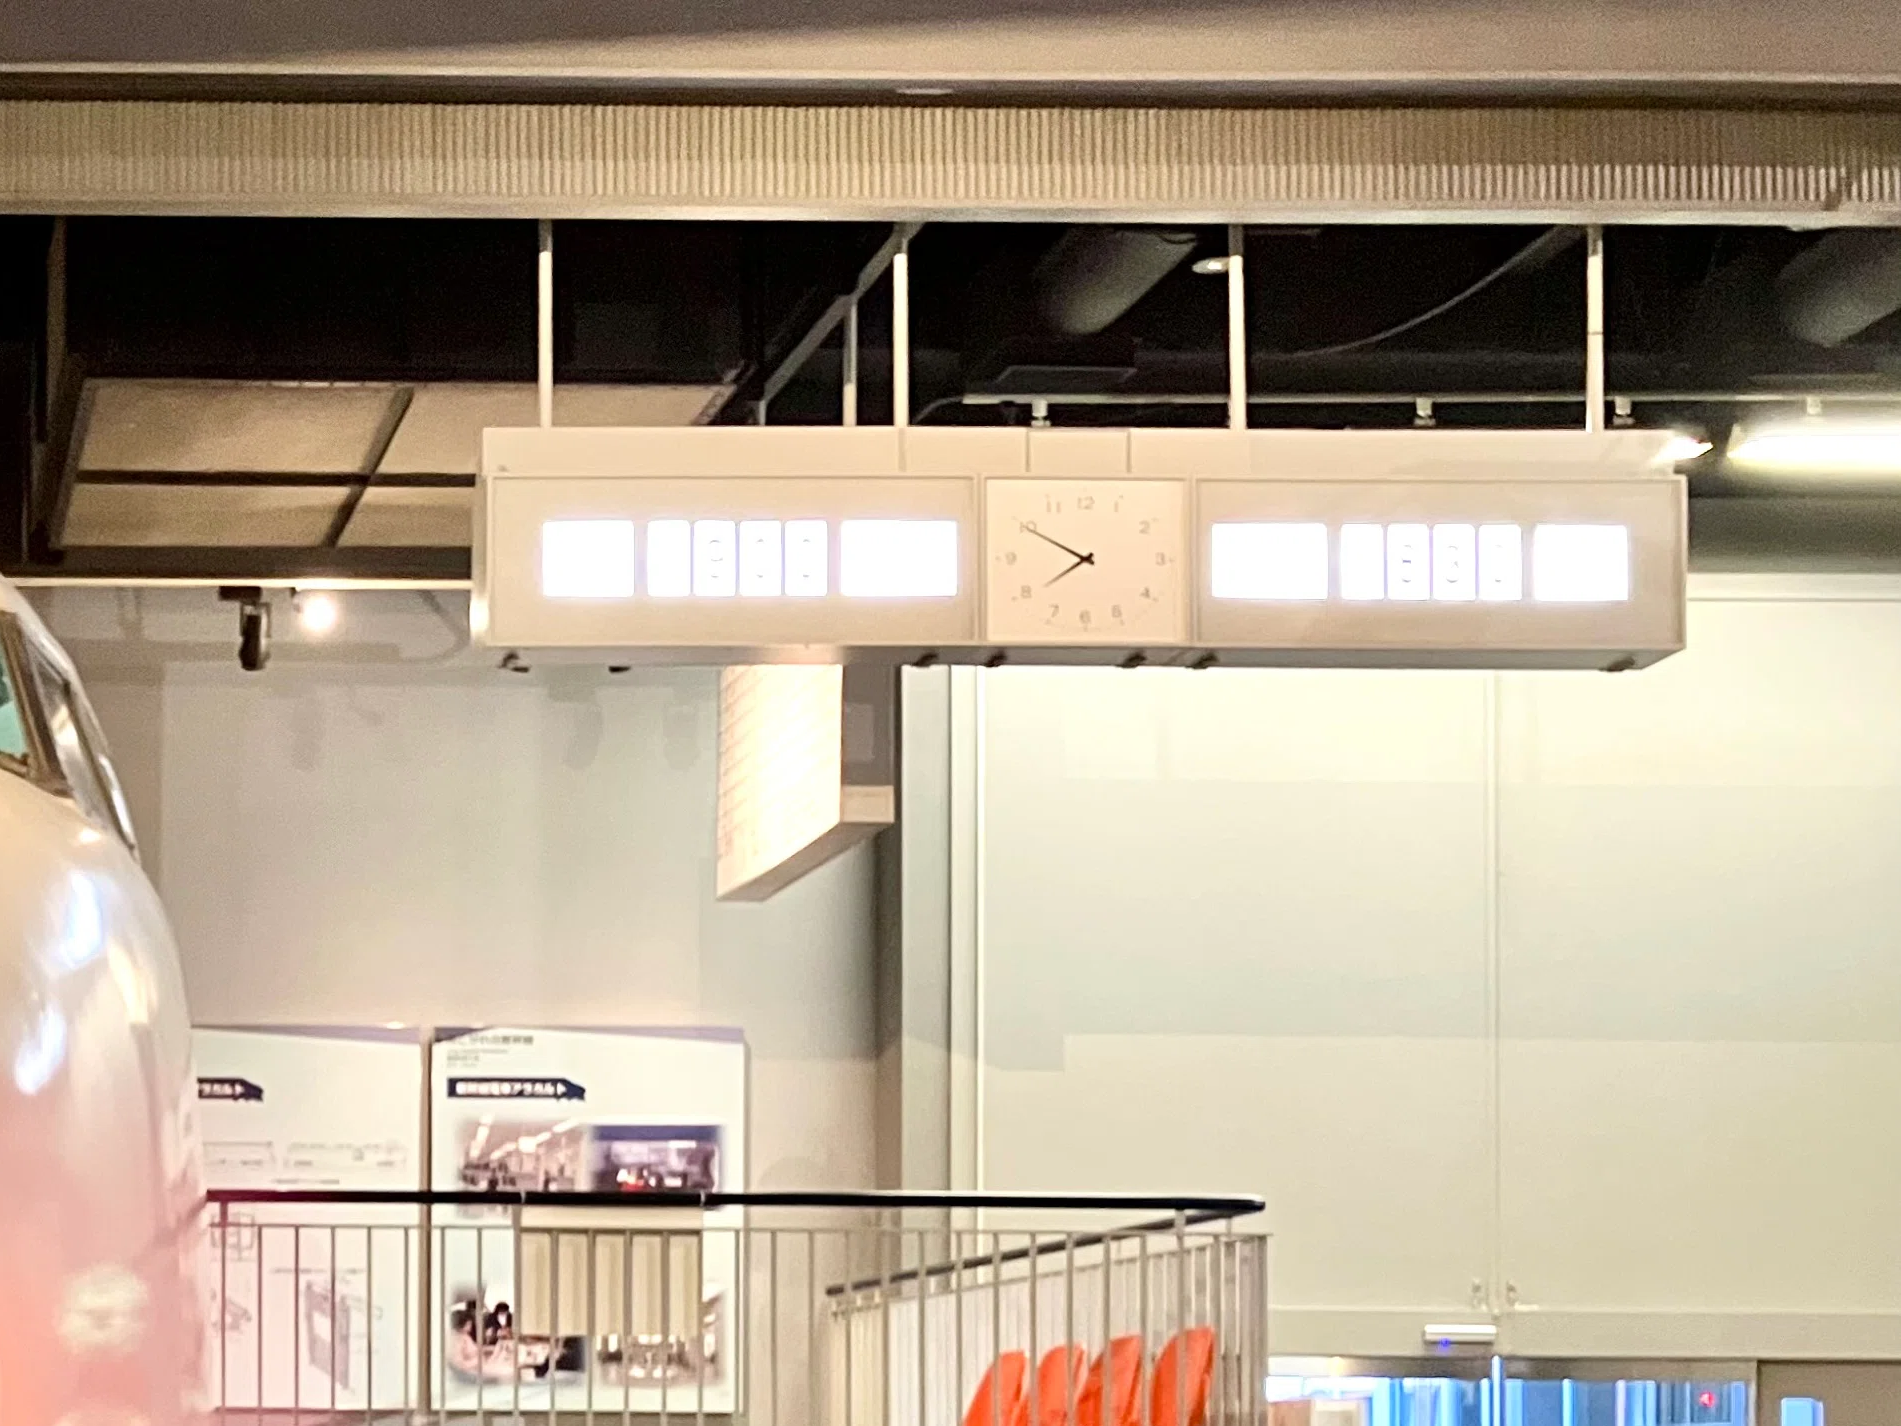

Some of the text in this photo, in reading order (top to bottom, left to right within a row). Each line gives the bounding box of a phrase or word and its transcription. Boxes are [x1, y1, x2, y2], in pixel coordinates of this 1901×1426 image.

[1077, 496, 1095, 510] 12
[1019, 520, 1038, 534] 10
[1138, 520, 1151, 535] 2
[1005, 551, 1017, 566] 9
[1155, 551, 1166, 567] 3
[1020, 584, 1033, 599] 8
[1139, 585, 1151, 600] 4
[1048, 603, 1060, 618] 7
